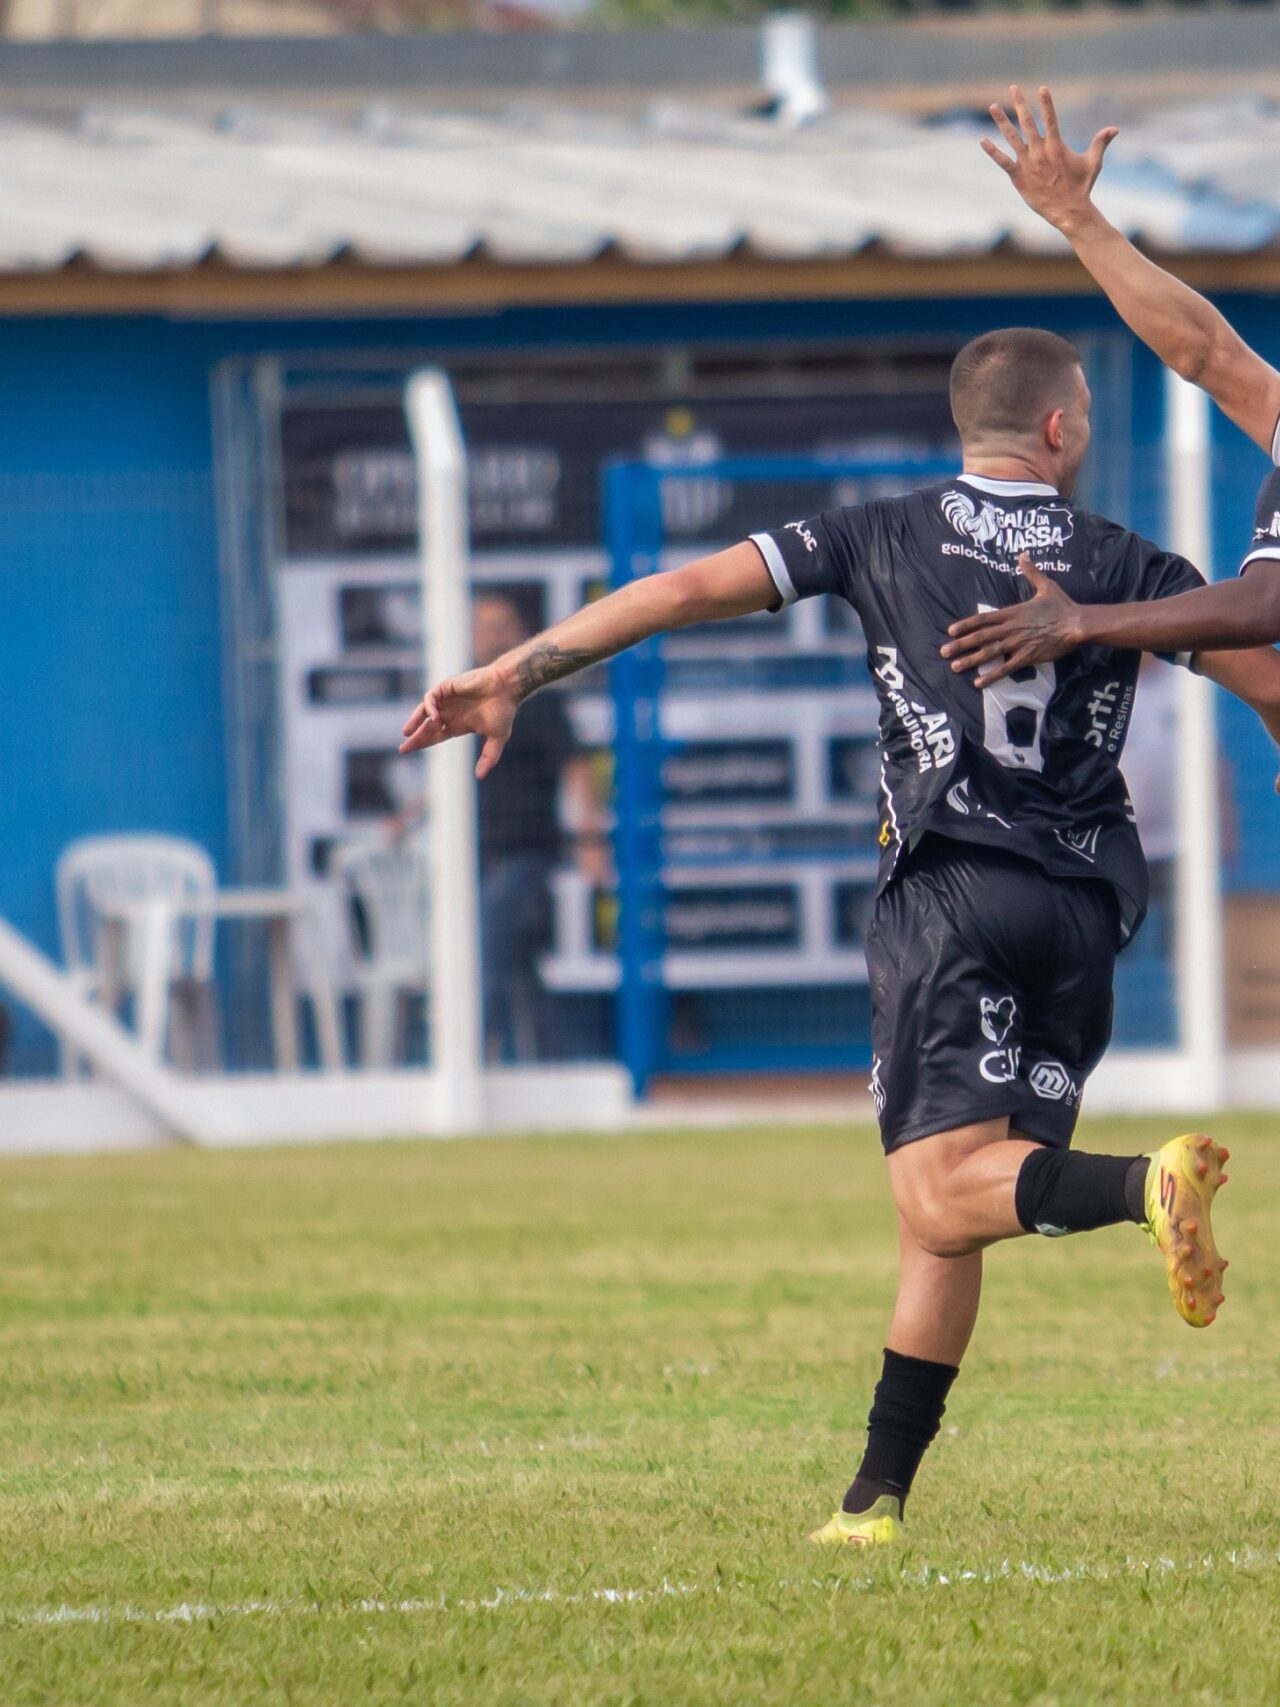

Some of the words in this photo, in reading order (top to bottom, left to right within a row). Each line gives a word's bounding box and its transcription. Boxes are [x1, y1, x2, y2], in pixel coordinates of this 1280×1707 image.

[1036, 514, 1050, 526] DA
[996, 525, 1064, 553] MASSA
[1109, 686, 1133, 740] Resinas
